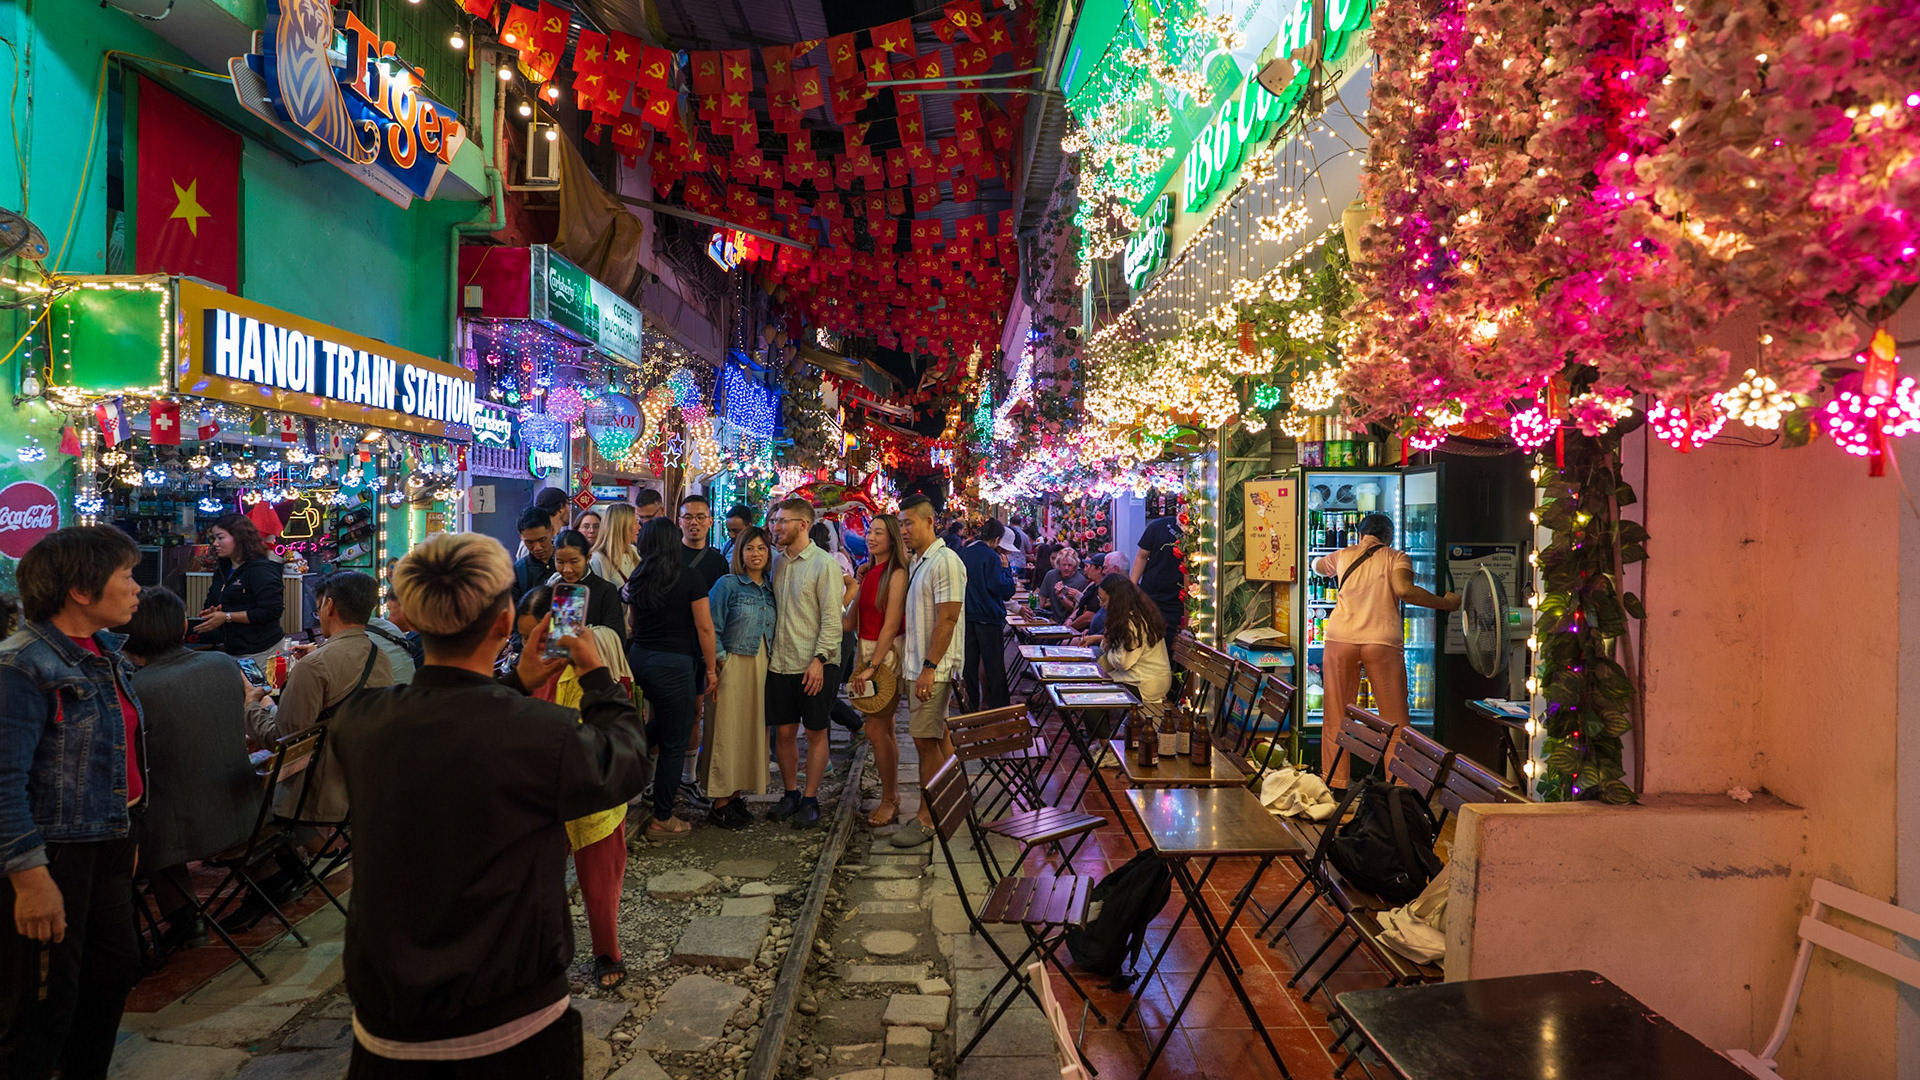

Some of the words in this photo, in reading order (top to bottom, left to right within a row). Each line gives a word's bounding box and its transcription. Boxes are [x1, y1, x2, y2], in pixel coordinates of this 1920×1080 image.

[345, 10, 459, 169] Tiger
[1183, 99, 1231, 213] H86
[549, 267, 574, 303] Carlsberg
[614, 304, 633, 326] COFFEE
[215, 308, 316, 394] HANOI
[322, 340, 397, 410] TRAIN
[402, 364, 476, 426] STATION
[472, 403, 512, 443] Carlsberg
